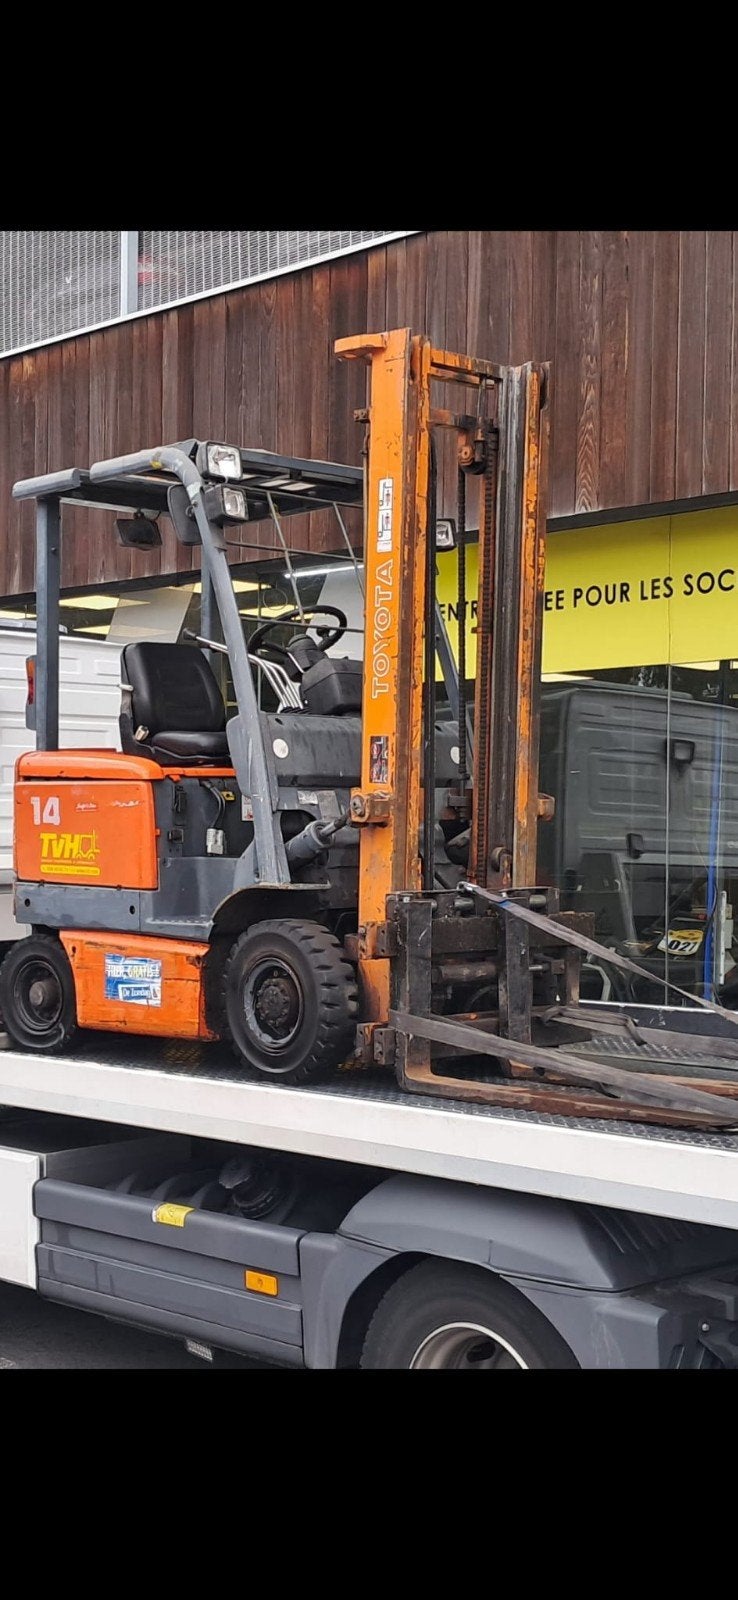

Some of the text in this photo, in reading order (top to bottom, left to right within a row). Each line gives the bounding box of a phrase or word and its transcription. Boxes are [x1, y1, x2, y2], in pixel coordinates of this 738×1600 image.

[573, 582, 630, 608] POUR
[640, 576, 674, 601] LES
[371, 559, 393, 699] TOYOTA
[30, 796, 61, 826] 14
